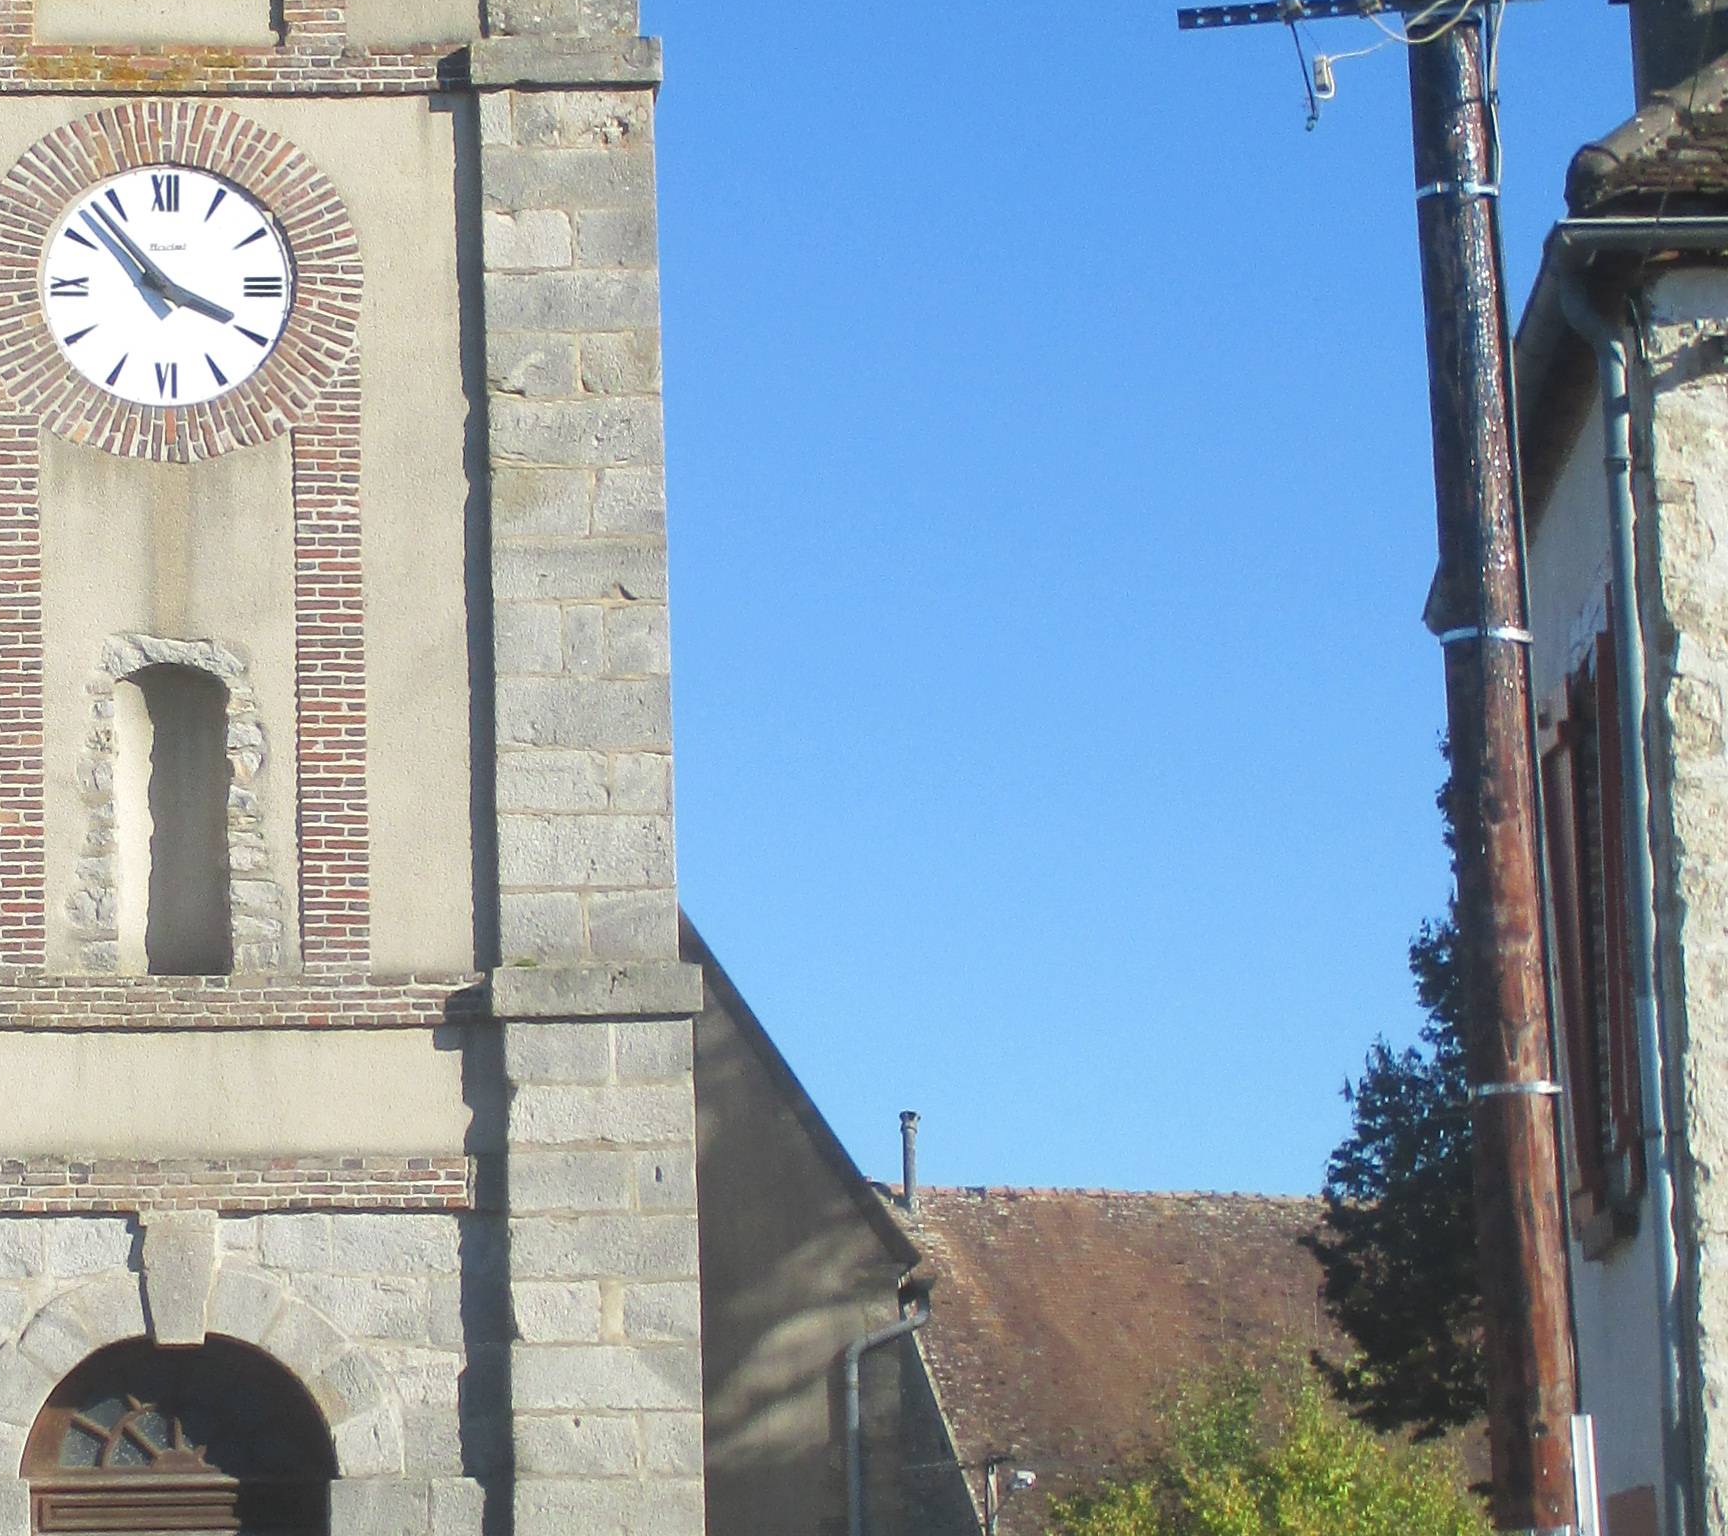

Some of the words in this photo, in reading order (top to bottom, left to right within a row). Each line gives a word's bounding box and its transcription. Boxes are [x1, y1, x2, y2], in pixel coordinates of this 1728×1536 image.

[151, 174, 180, 212] XII
[50, 276, 89, 297] IX
[243, 276, 283, 297] III
[154, 362, 178, 399] VI
